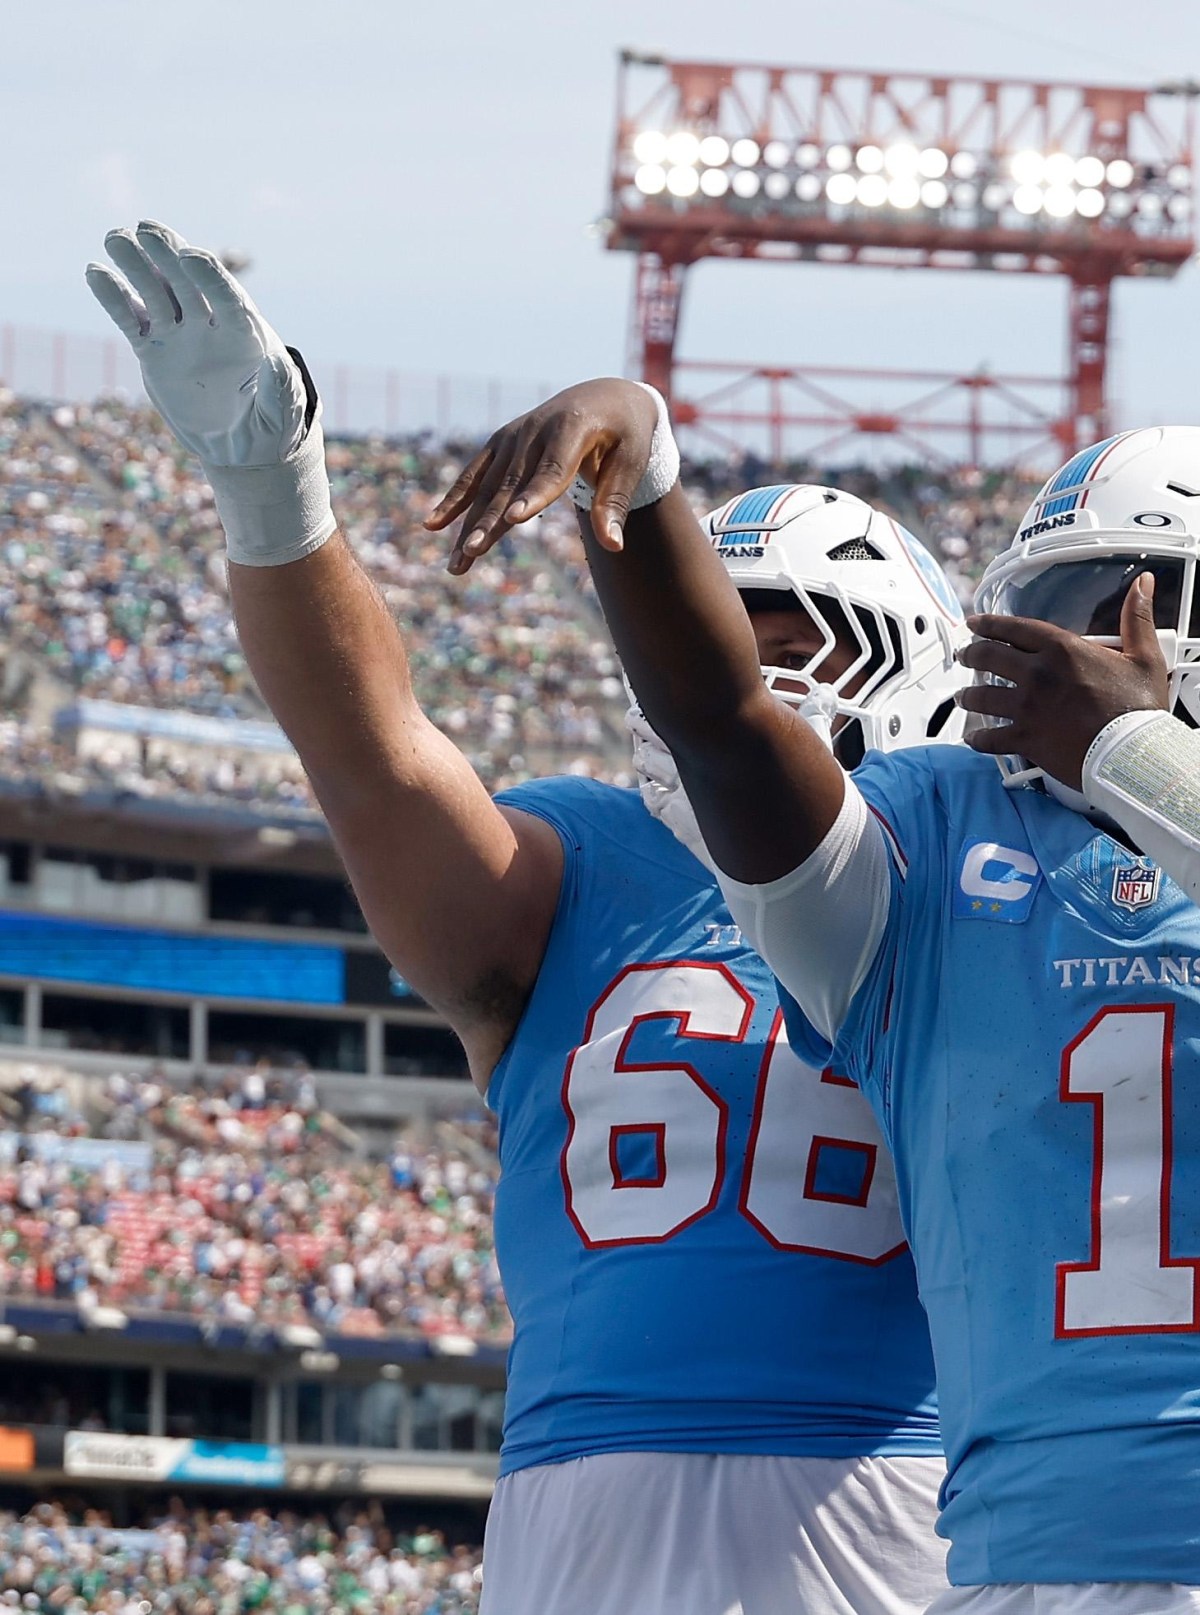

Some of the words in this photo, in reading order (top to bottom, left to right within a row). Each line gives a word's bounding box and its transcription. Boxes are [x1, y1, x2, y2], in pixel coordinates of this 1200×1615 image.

[1020, 512, 1077, 542] TITANS
[716, 546, 765, 558] TANS
[959, 841, 1039, 901] C
[1118, 881, 1151, 902] NFL
[560, 959, 910, 1267] 66
